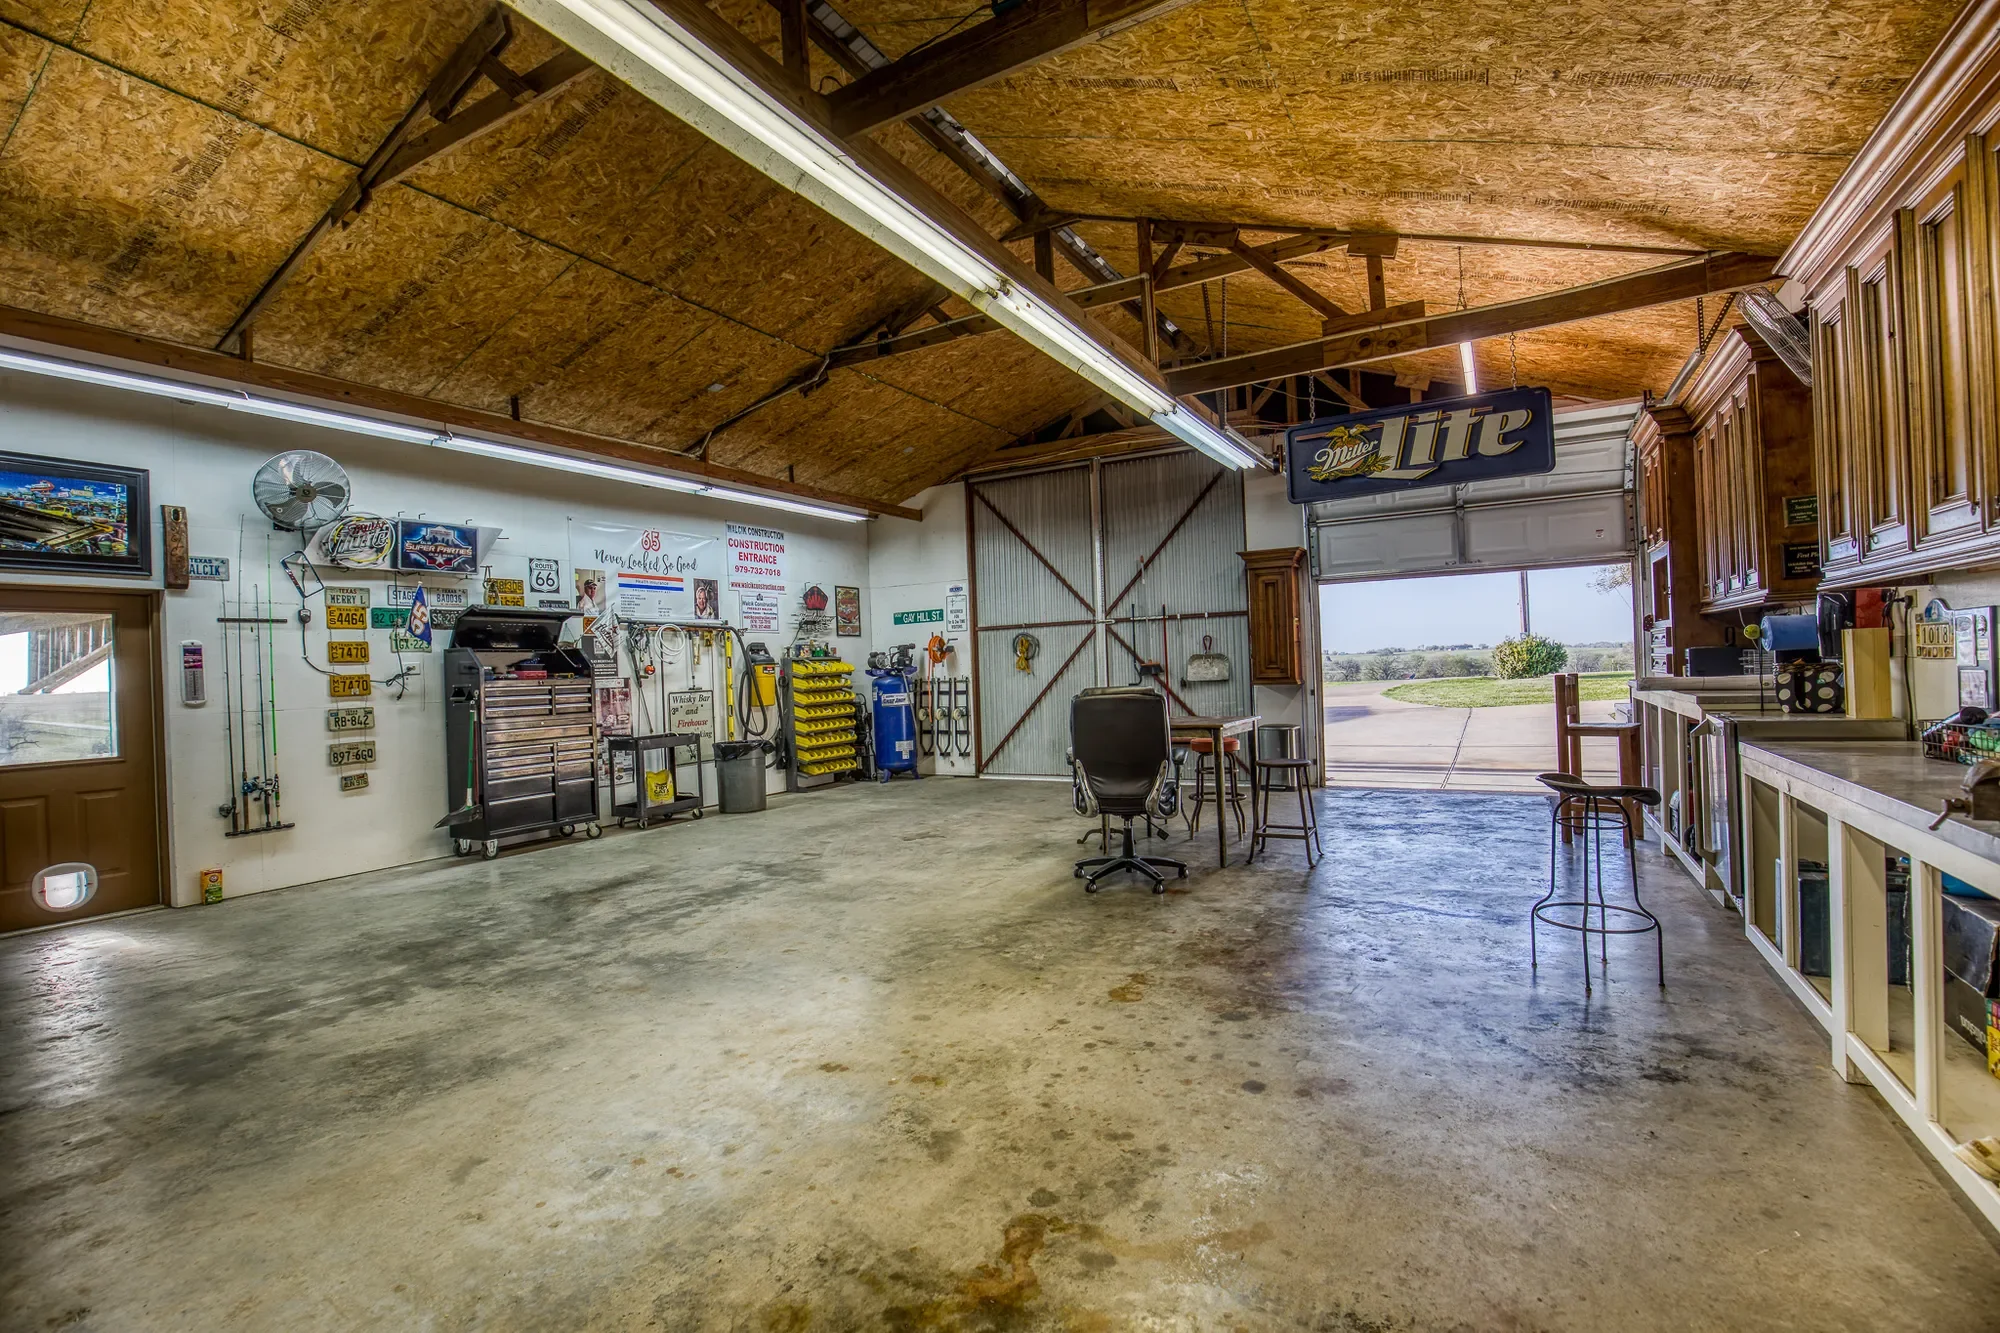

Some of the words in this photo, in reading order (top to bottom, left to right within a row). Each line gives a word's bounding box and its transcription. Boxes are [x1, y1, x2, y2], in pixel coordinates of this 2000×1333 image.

[1314, 440, 1379, 472] Miller
[1366, 407, 1533, 480] Lite
[747, 527, 785, 540] CONSTRUCTION
[642, 530, 661, 551] 65
[728, 538, 785, 554] CONSTRUCTION
[406, 542, 435, 552] SUPER
[437, 546, 473, 556] PARTIES
[594, 549, 625, 568] Never
[627, 550, 660, 573] Looked
[662, 553, 675, 575] So
[676, 555, 698, 573] Good
[738, 552, 777, 565] ENTRANCE
[535, 562, 554, 570] ROUTE
[734, 565, 781, 577] 979-732-7018
[535, 571, 556, 588] 66
[330, 594, 356, 604] MERRY
[360, 595, 366, 605] L
[336, 612, 365, 626] 4464
[903, 613, 915, 623] GAY
[916, 612, 931, 622] HILL
[931, 611, 942, 621] ST.
[338, 647, 367, 659] 7470
[340, 679, 369, 693] 7470
[672, 694, 696, 705] Whisky
[698, 694, 711, 703] Bar
[685, 707, 699, 715] and
[677, 719, 709, 728] Firehouse
